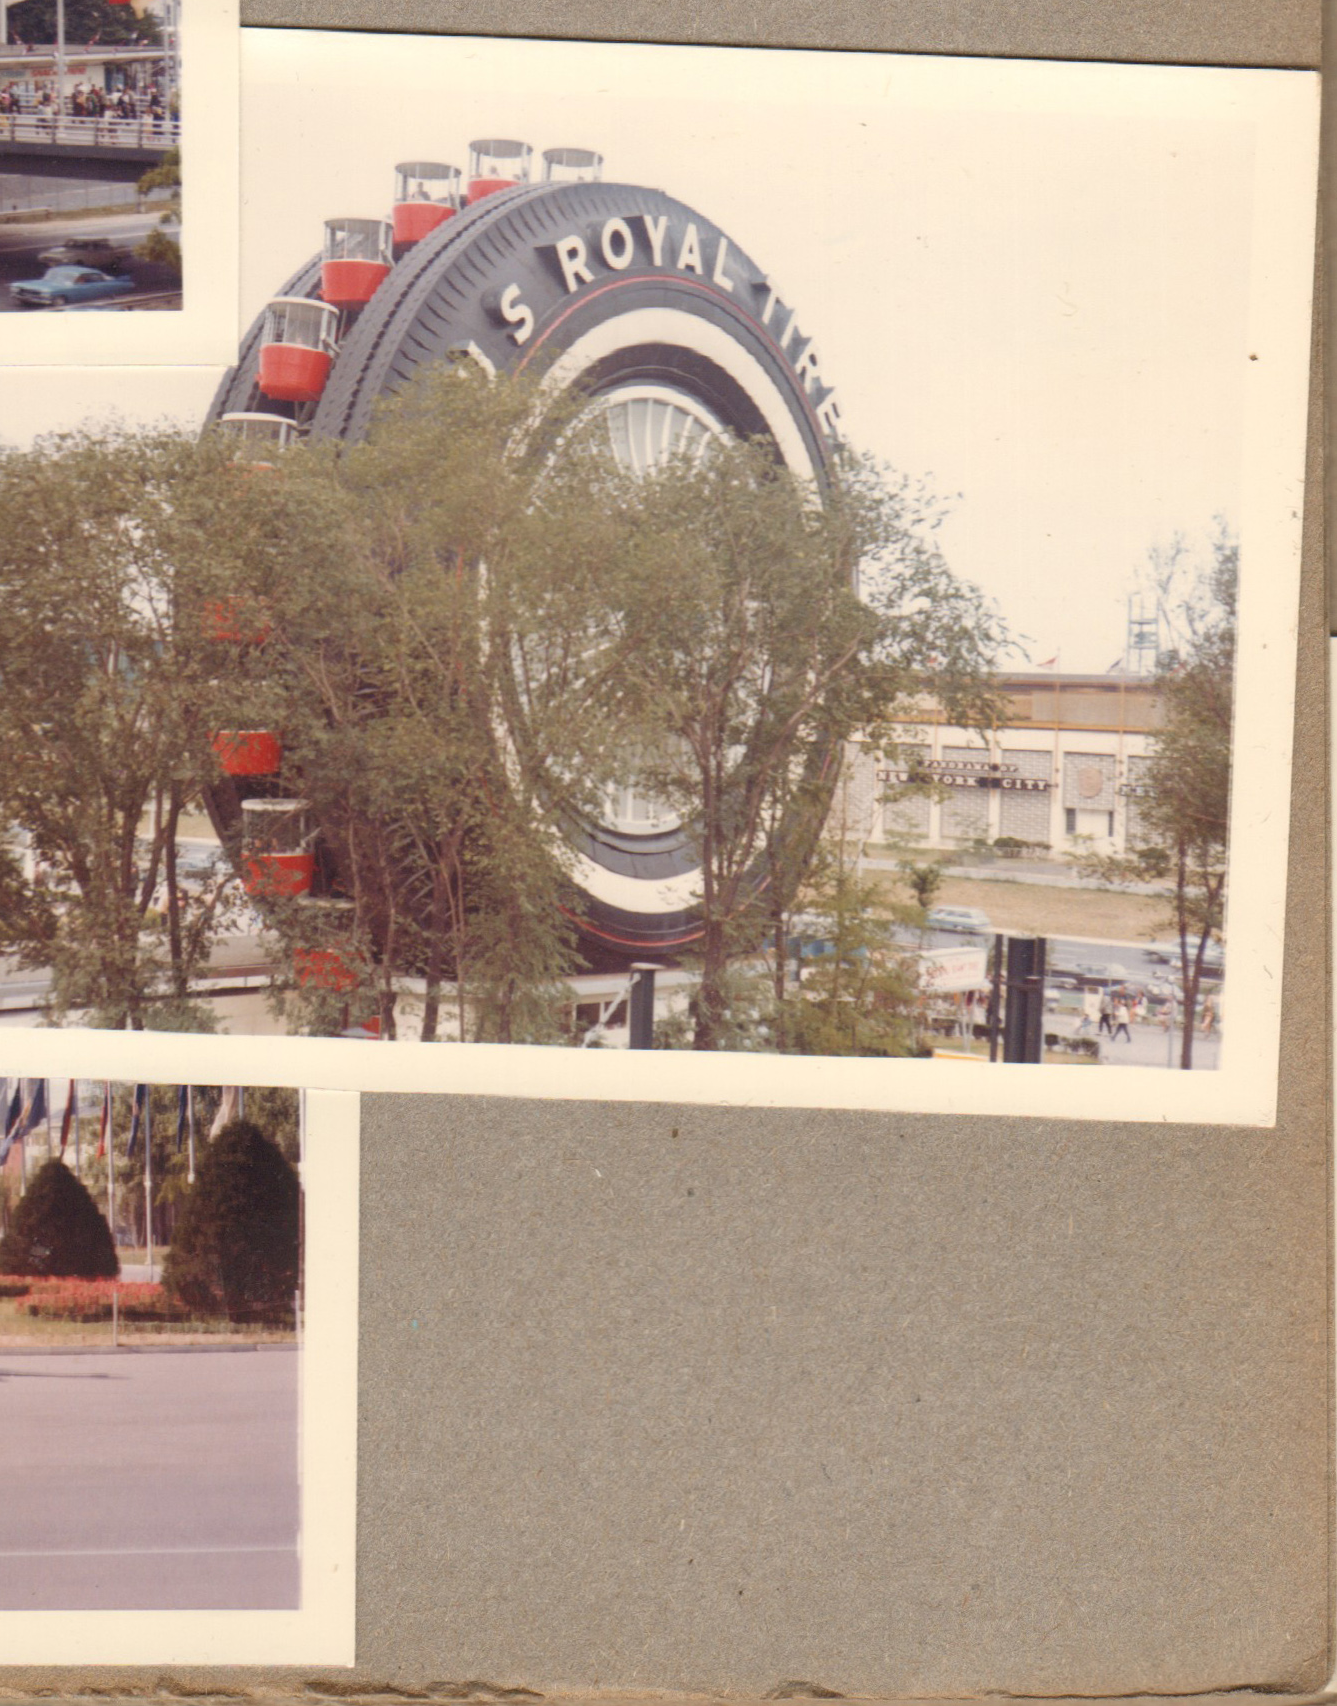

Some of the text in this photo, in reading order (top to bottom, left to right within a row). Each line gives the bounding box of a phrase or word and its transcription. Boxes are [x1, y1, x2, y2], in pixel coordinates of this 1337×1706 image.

[556, 214, 734, 294] ROYAL
[761, 275, 845, 446] TIRE
[932, 773, 978, 786] YORK
[1001, 778, 1048, 791] CITY
